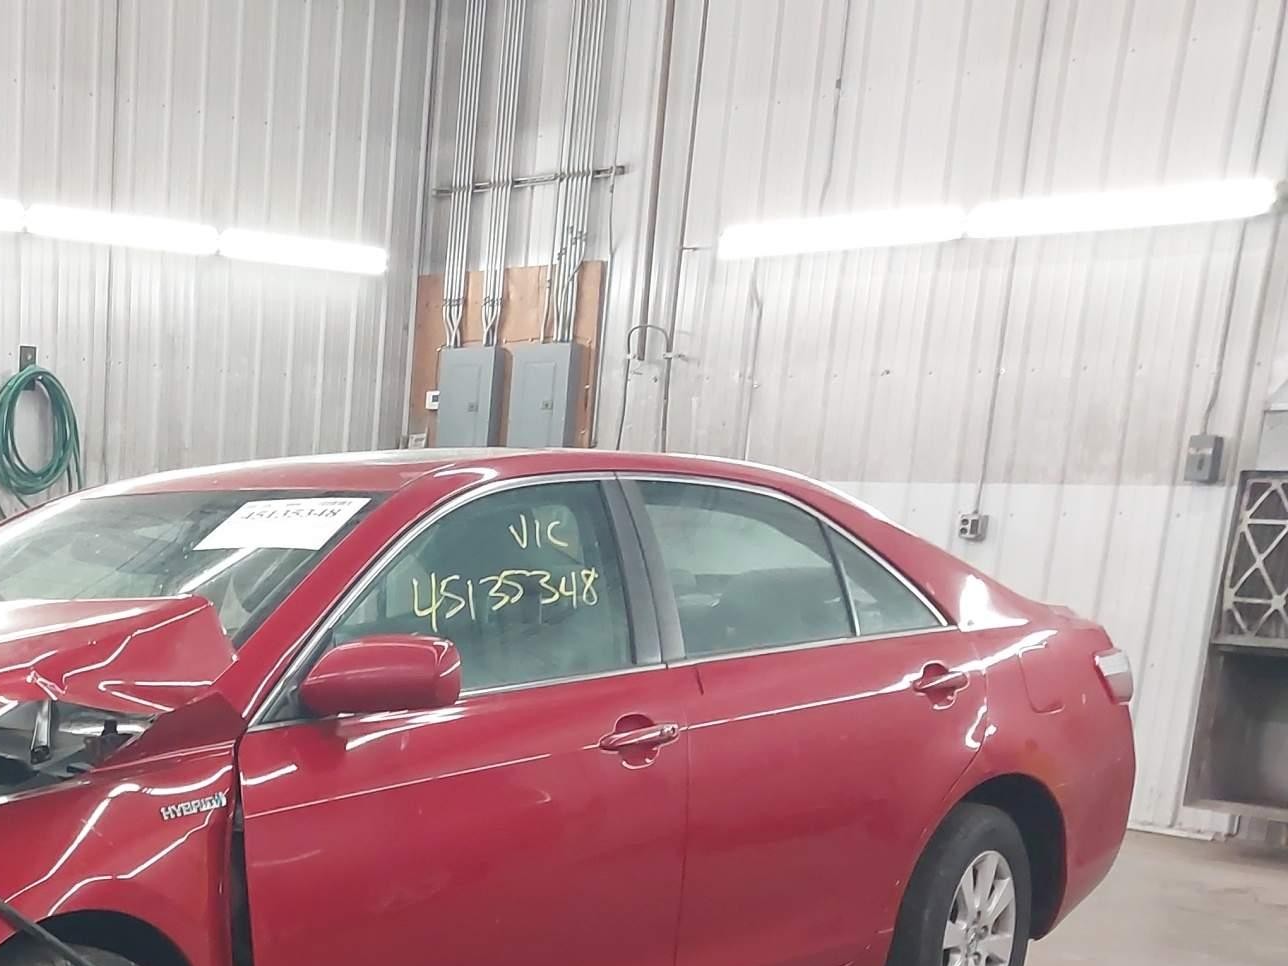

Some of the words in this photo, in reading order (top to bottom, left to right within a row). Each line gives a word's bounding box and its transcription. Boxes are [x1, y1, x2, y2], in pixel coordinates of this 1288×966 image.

[509, 514, 569, 549] VIC
[412, 567, 599, 632] 45135348
[160, 795, 216, 820] HYBRID
